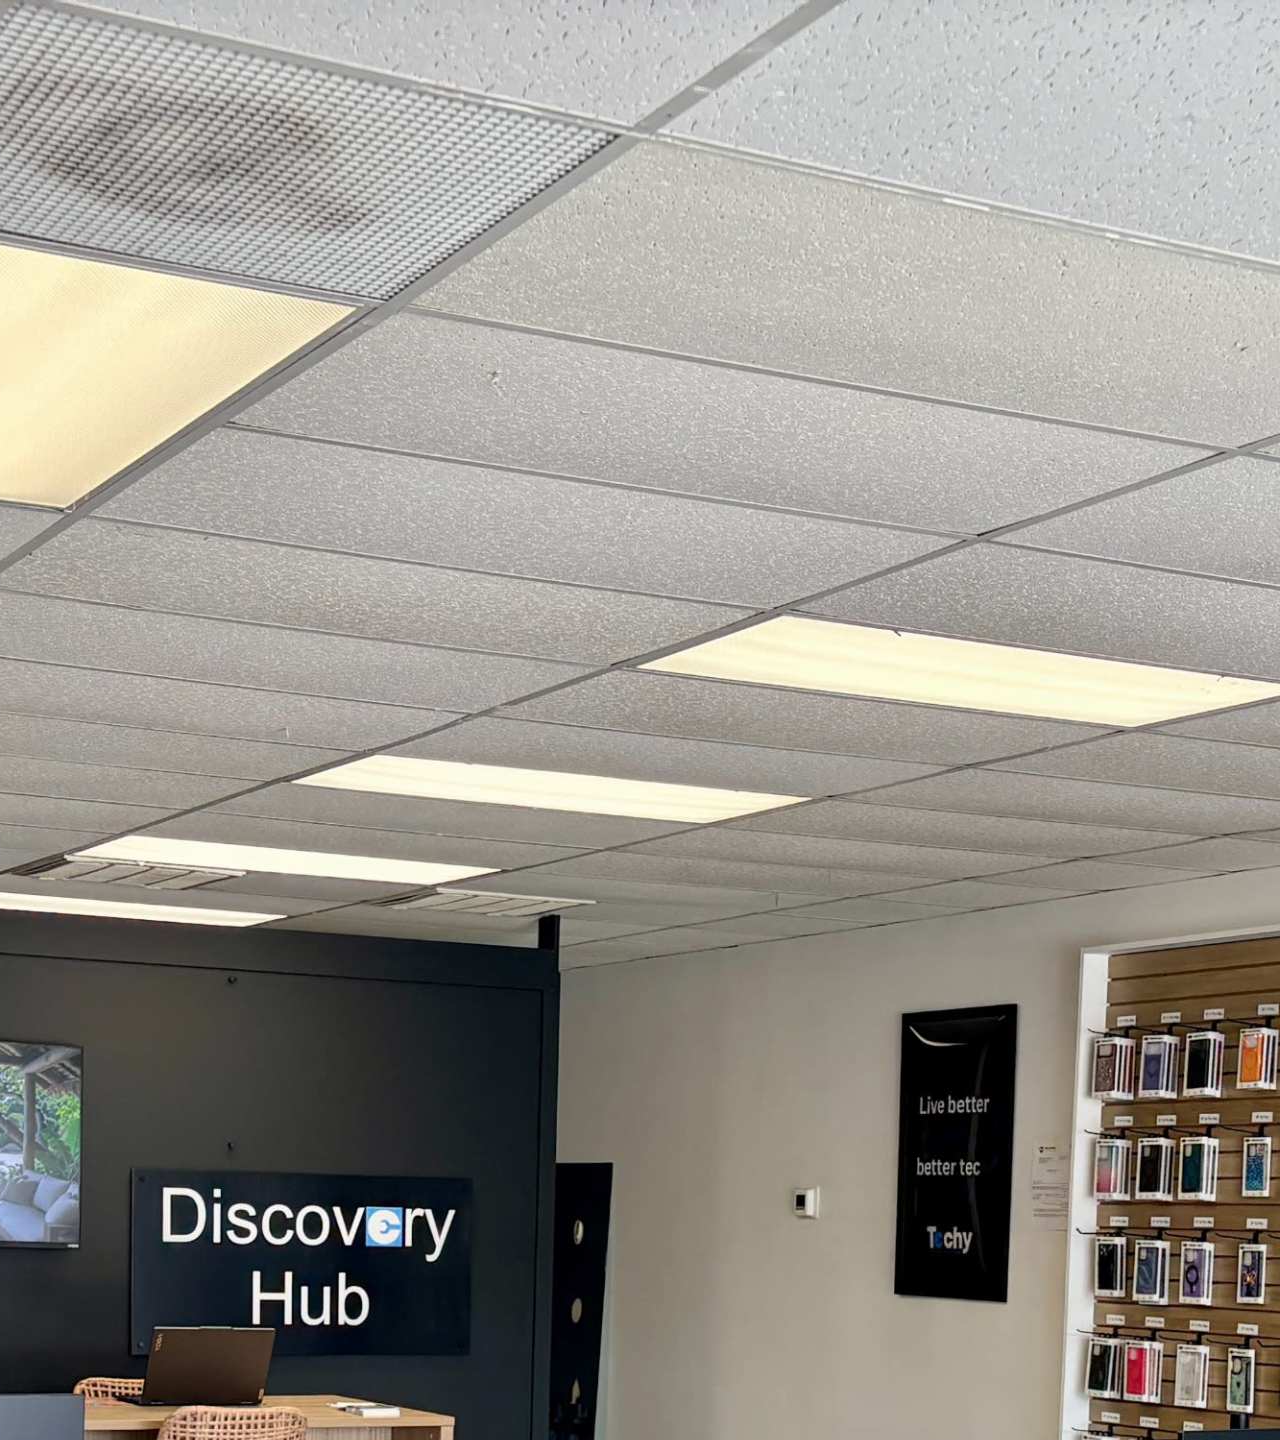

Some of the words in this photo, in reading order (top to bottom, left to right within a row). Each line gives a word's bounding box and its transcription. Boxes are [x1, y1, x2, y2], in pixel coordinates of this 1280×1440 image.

[919, 1096, 945, 1115] Live
[947, 1095, 990, 1114] better
[916, 1157, 957, 1176] better
[959, 1158, 981, 1176] tec
[161, 1186, 456, 1262] Discovery
[927, 1226, 973, 1254] Techy
[251, 1271, 370, 1327] Hub
